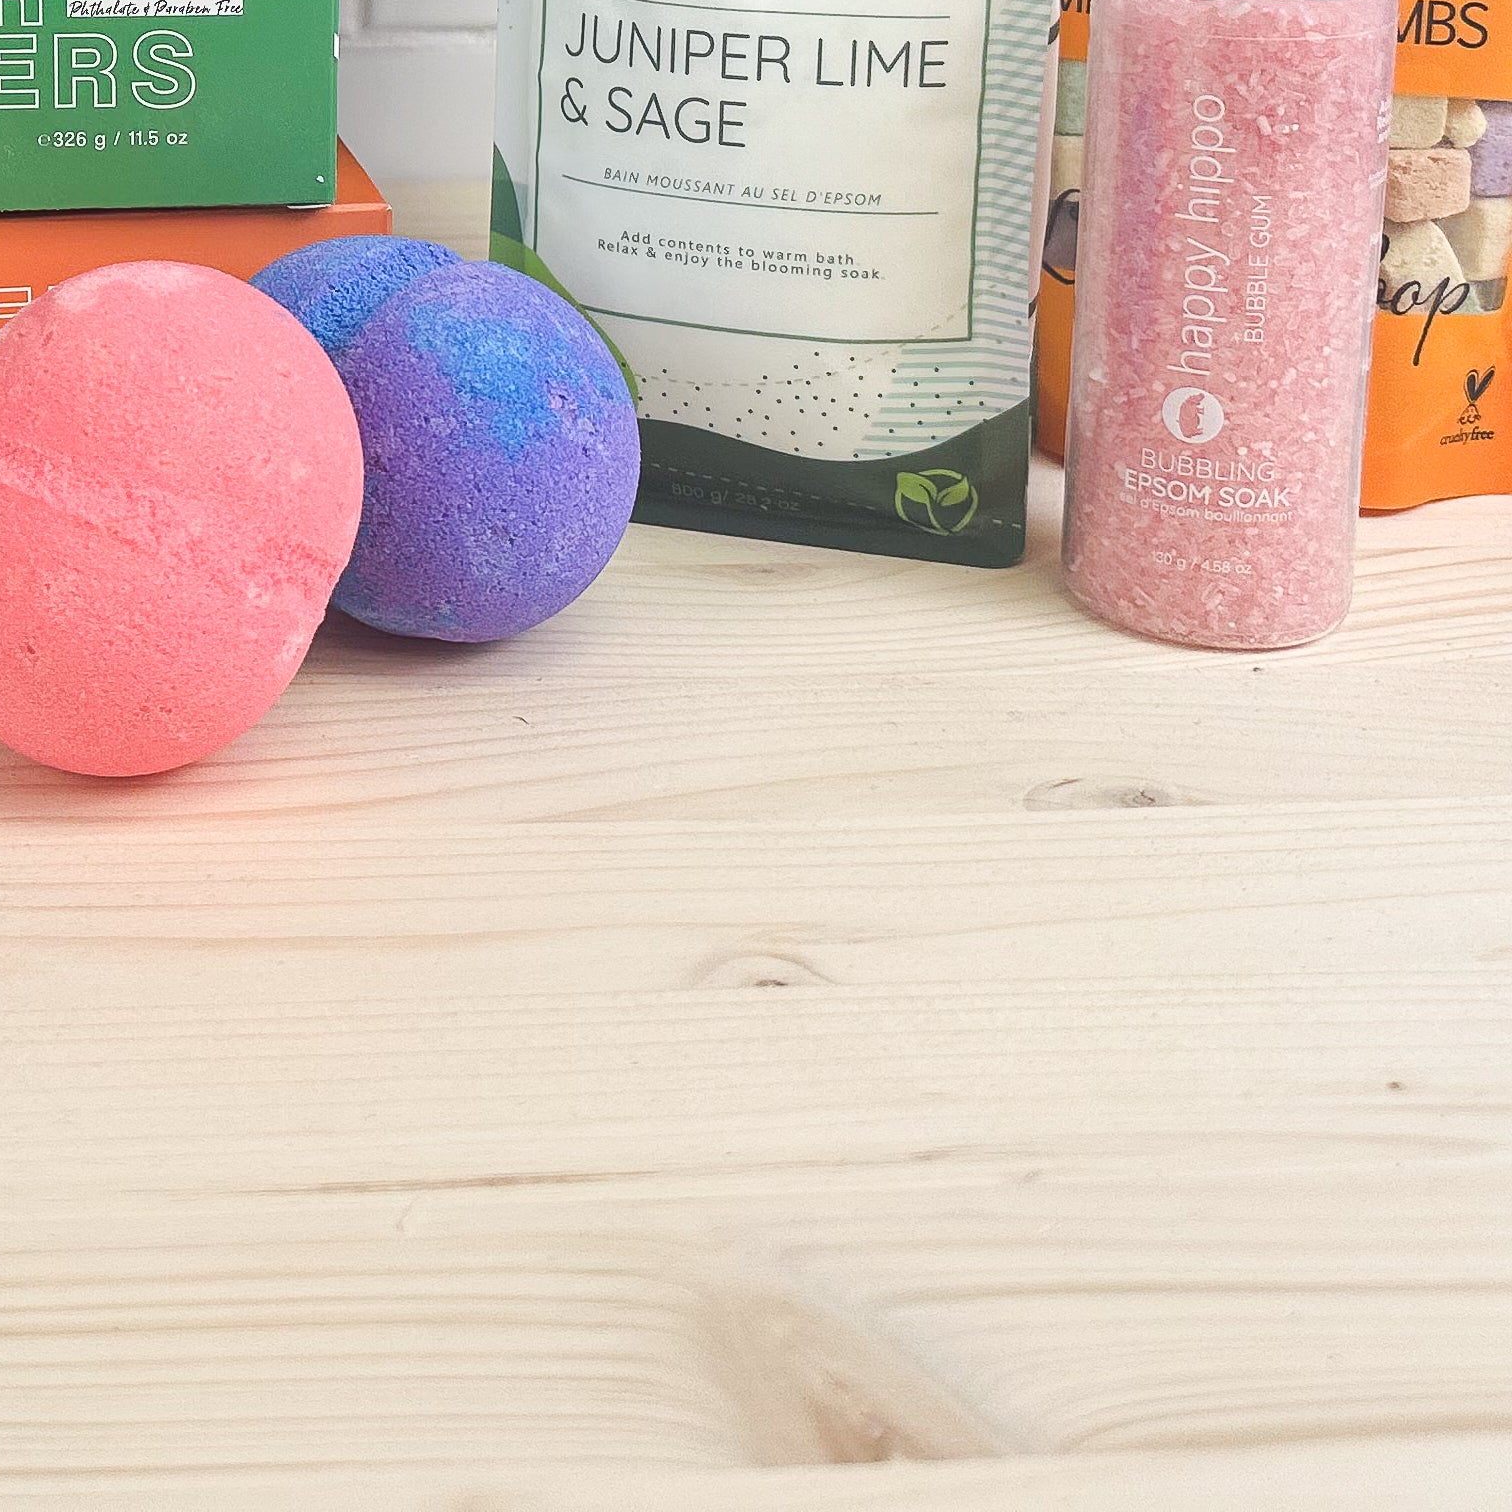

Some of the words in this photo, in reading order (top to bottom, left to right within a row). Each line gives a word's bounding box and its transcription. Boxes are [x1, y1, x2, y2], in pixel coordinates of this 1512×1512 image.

[68, 0, 140, 18] Phthalate
[153, 0, 211, 17] Paraben
[214, 0, 244, 15] Free
[1397, 0, 1489, 50] MBS
[564, 12, 791, 85] JUNIPER
[815, 37, 950, 89] LIME
[560, 76, 590, 128] &
[604, 85, 749, 149] SAGE
[94, 134, 107, 150] g
[113, 130, 122, 146] /
[128, 130, 159, 146] 11.5
[166, 132, 189, 145] oz
[1174, 94, 1238, 223] hippo
[603, 166, 640, 185] BAIN
[646, 174, 736, 196] MOUSSANT
[740, 185, 765, 201] AU
[771, 187, 799, 204] SEL
[805, 190, 883, 208] D'EPSOM
[1249, 194, 1273, 249] GUM
[597, 237, 639, 257] Relax
[645, 245, 658, 259] &
[664, 249, 710, 268] enjoy
[716, 255, 744, 270] the
[750, 259, 834, 281] blooming
[620, 229, 652, 246] Add
[657, 236, 731, 256] contents
[737, 245, 756, 259] to
[761, 248, 808, 264] warm
[1166, 236, 1232, 376] happy
[1243, 253, 1270, 344] BUBBLE
[1140, 446, 1277, 483] BUBBLING
[1123, 467, 1213, 506] EPSOM
[1217, 486, 1291, 509] SOAK
[1175, 557, 1188, 571] g
[1235, 563, 1253, 576] oz
